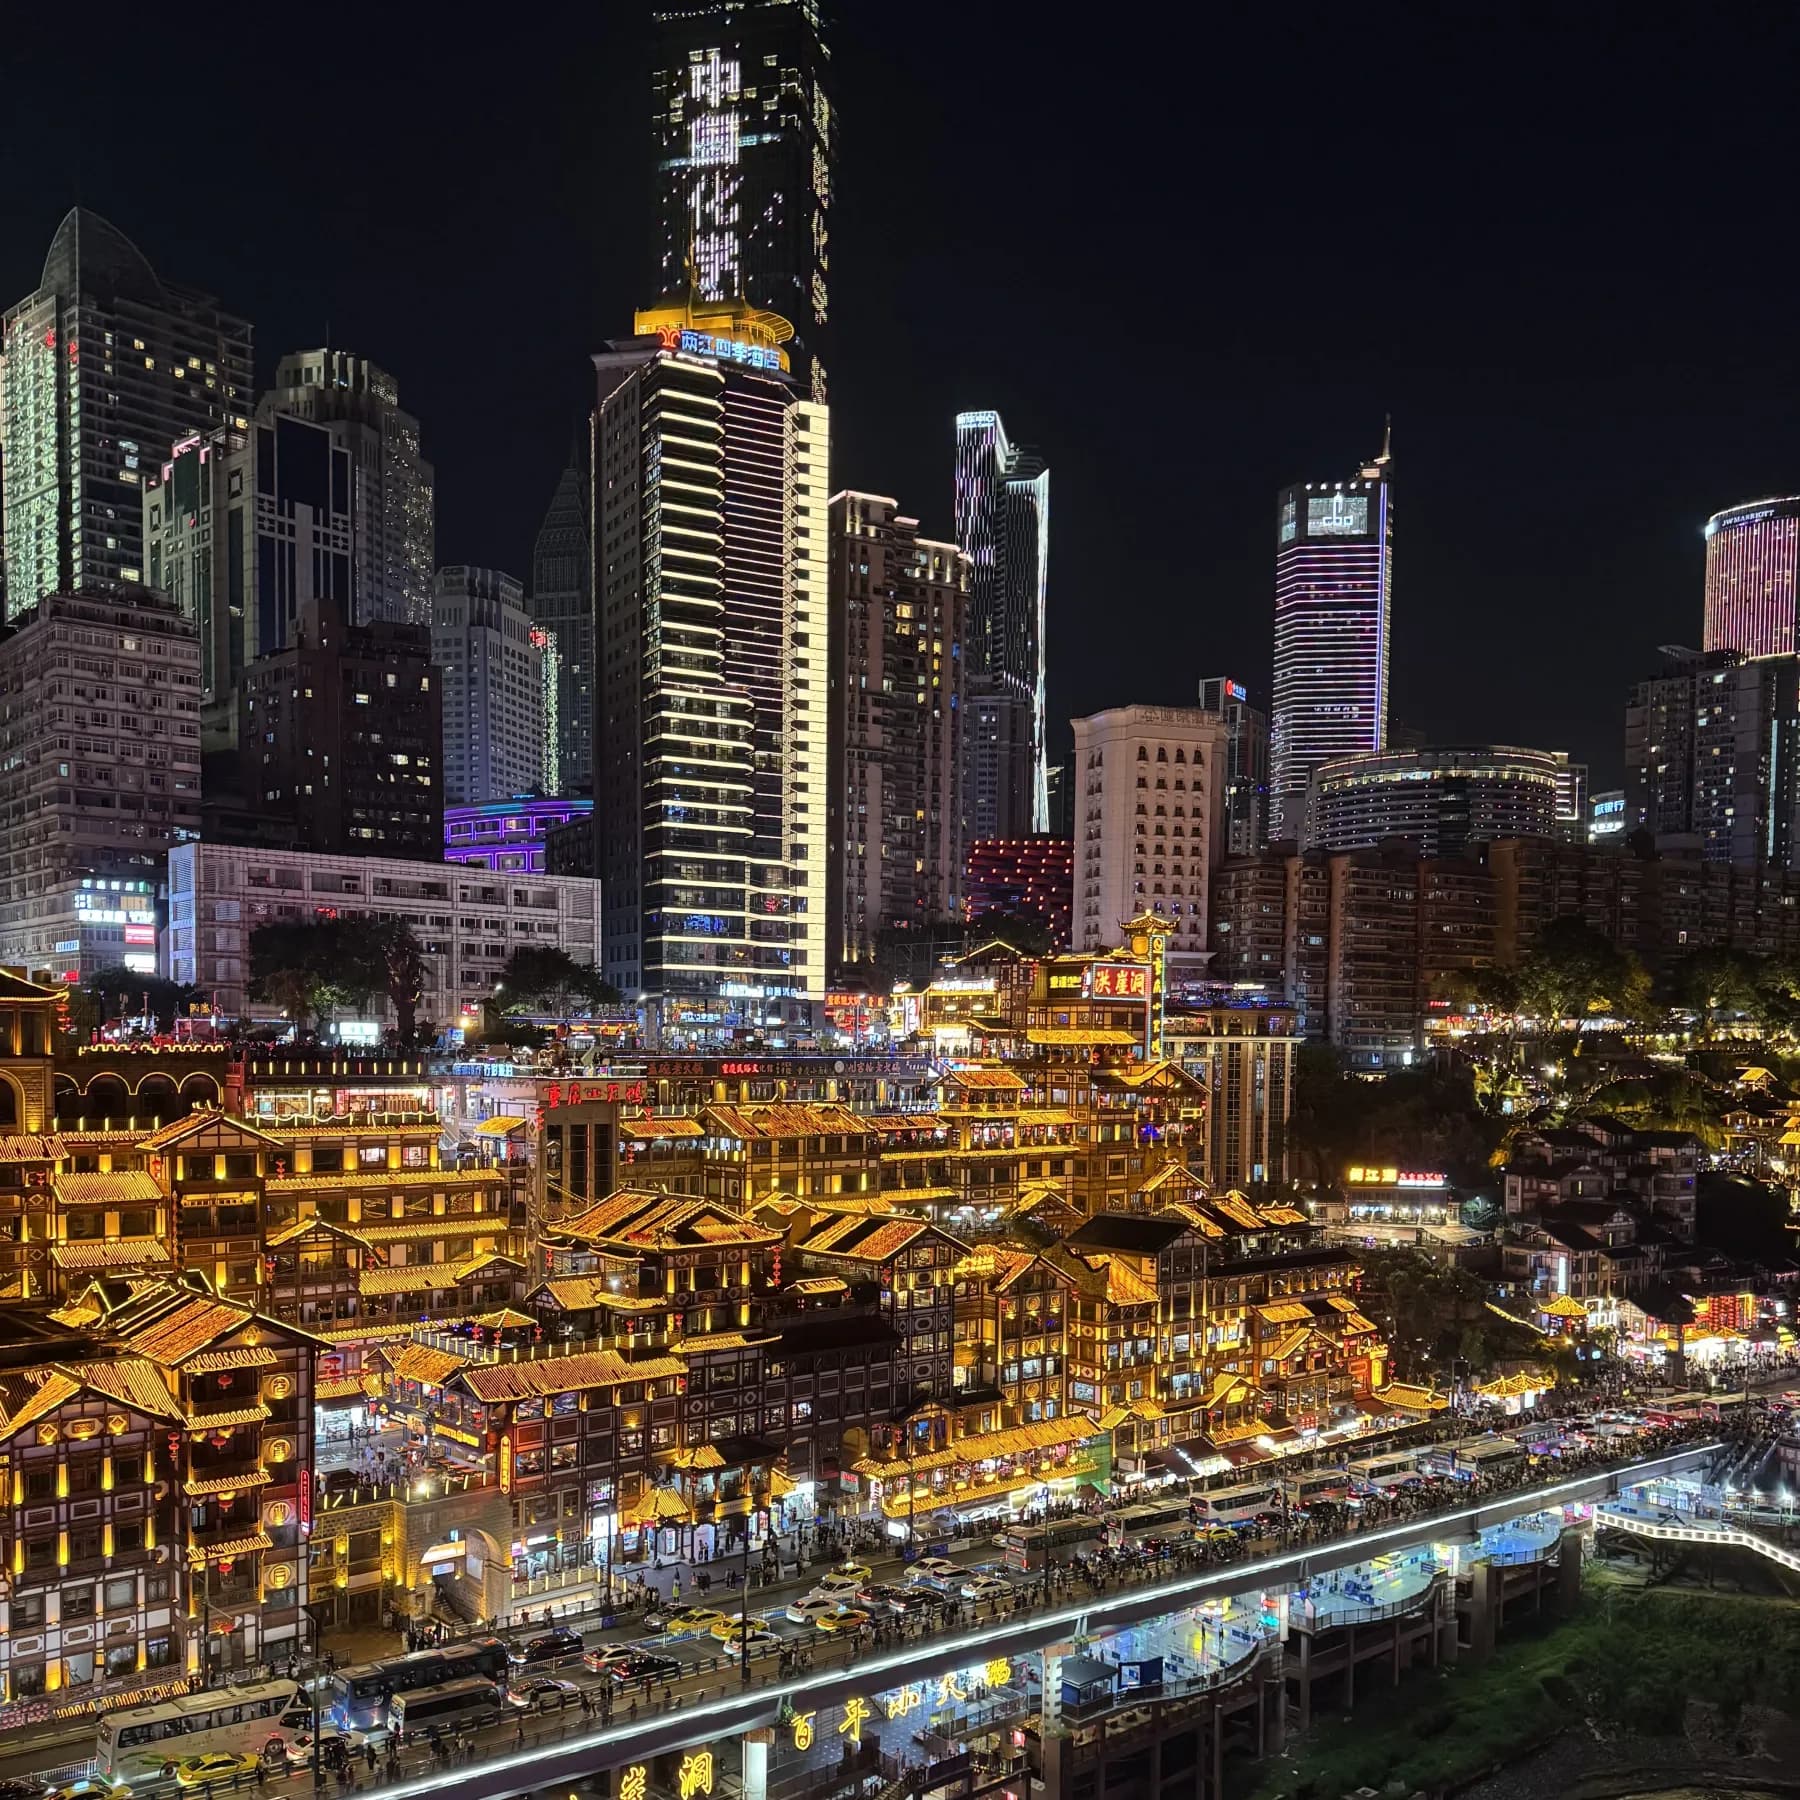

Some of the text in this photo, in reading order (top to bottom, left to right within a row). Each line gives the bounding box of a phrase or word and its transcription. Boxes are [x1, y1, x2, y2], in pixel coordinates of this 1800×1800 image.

[681, 330, 780, 370] 两江四季酒店
[1721, 509, 1775, 527] JW MARRIOTT
[1095, 970, 1145, 995] 洪崖洞
